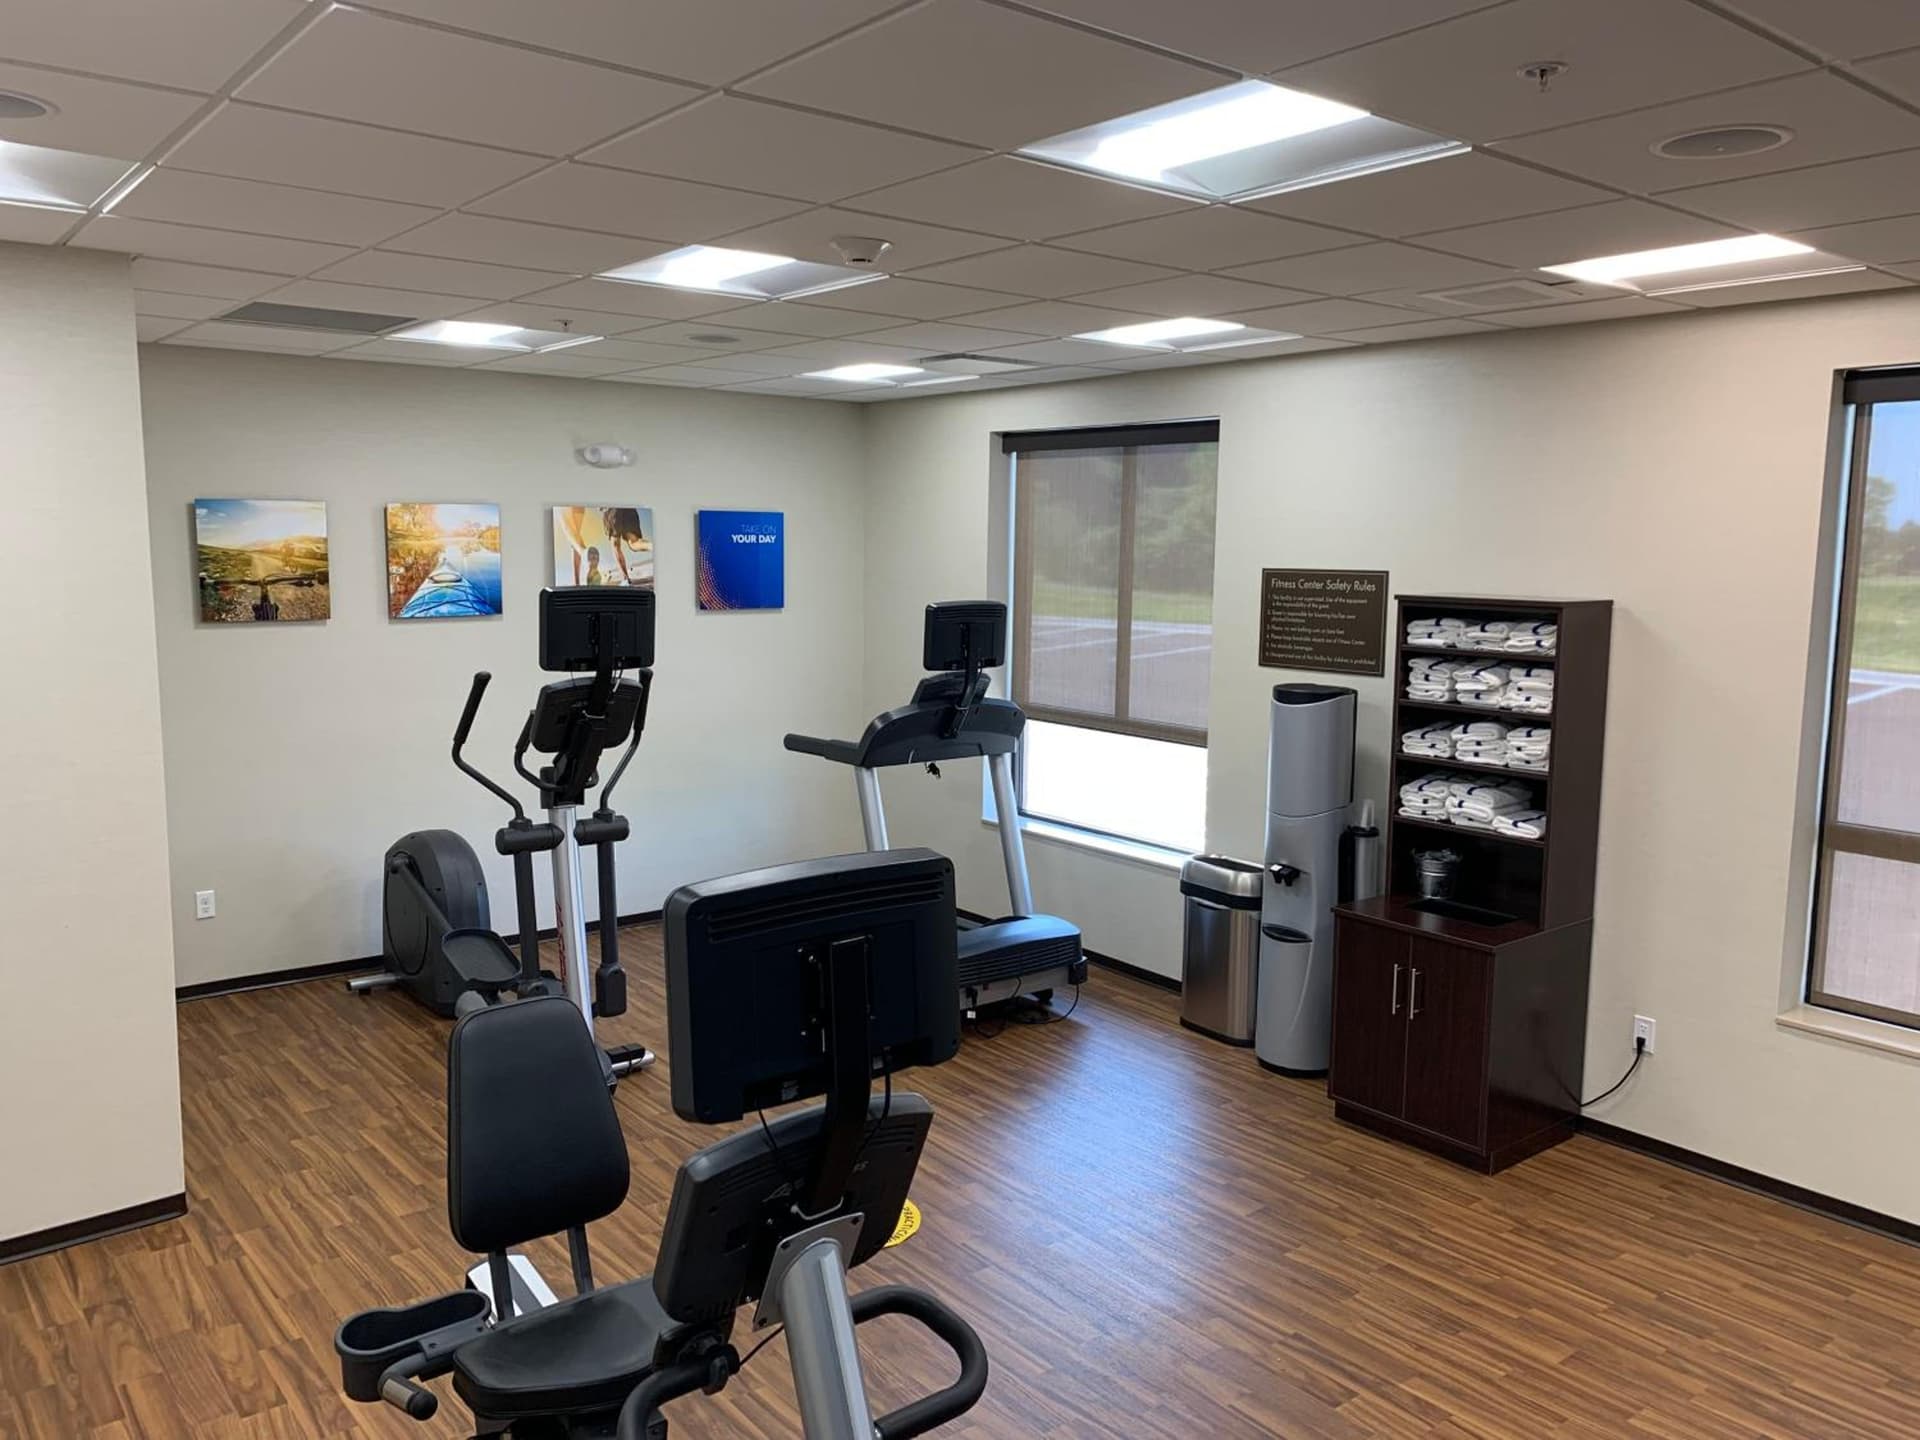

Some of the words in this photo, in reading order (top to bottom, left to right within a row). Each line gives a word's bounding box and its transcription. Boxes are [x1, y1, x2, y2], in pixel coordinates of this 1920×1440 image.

[731, 534, 757, 544] YOUR
[758, 534, 777, 544] DAY
[1271, 577, 1296, 589] Fitness
[1298, 578, 1325, 590] Center
[1326, 578, 1352, 593] Safety
[1353, 579, 1377, 592] Rules
